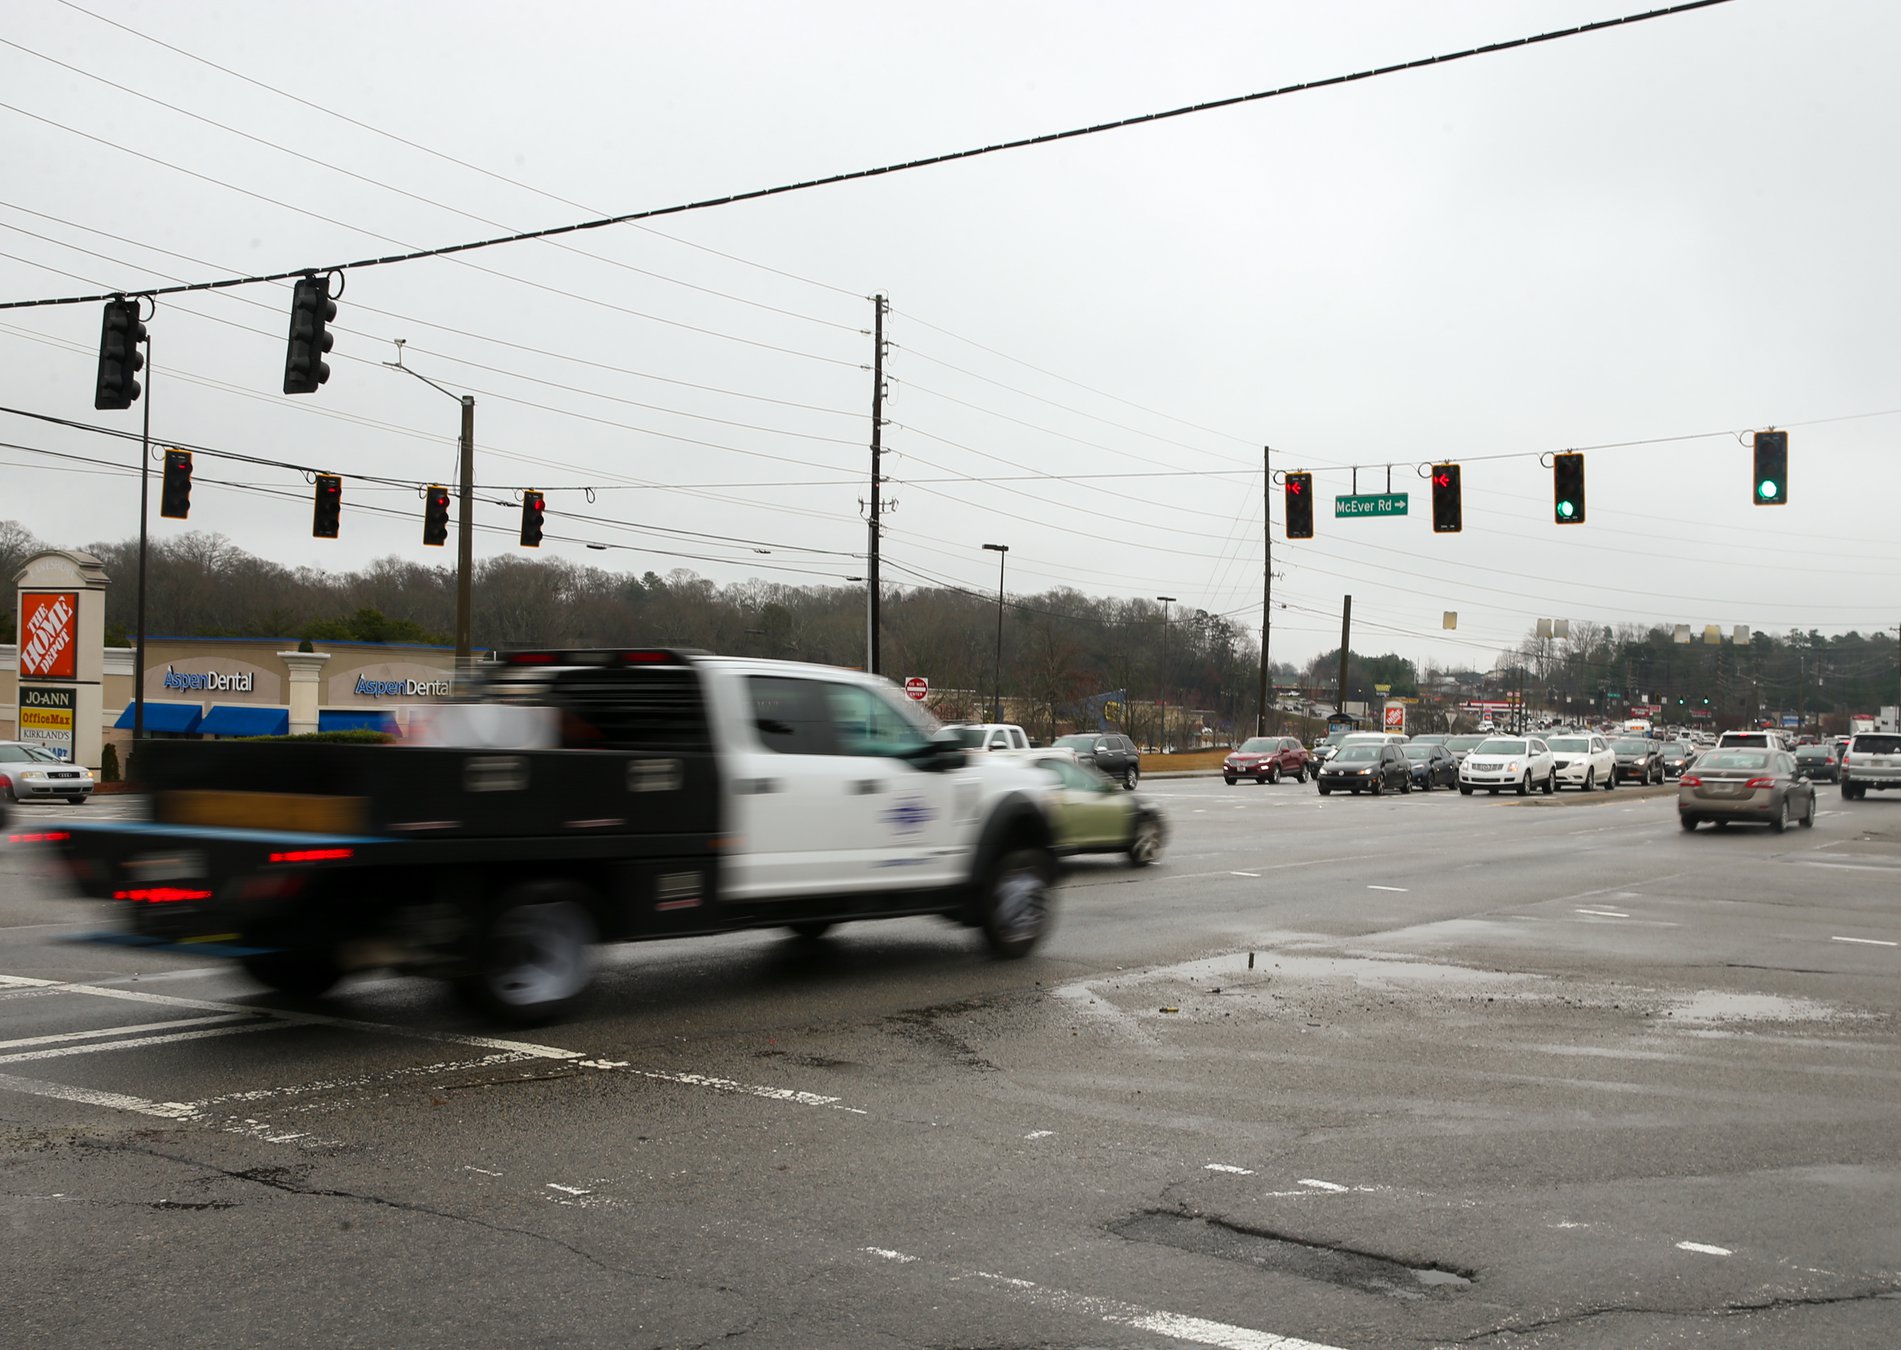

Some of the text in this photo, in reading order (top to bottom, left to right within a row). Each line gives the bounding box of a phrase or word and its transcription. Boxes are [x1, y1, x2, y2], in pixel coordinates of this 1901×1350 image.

[1336, 499, 1392, 513] McEver Rd
[27, 603, 48, 634] THE
[21, 595, 73, 674] HOME
[40, 628, 70, 674] DEPOT
[26, 691, 69, 705] JO-ANN
[23, 712, 70, 725] OfficeMax
[23, 729, 70, 740] KIRKLAND'S
